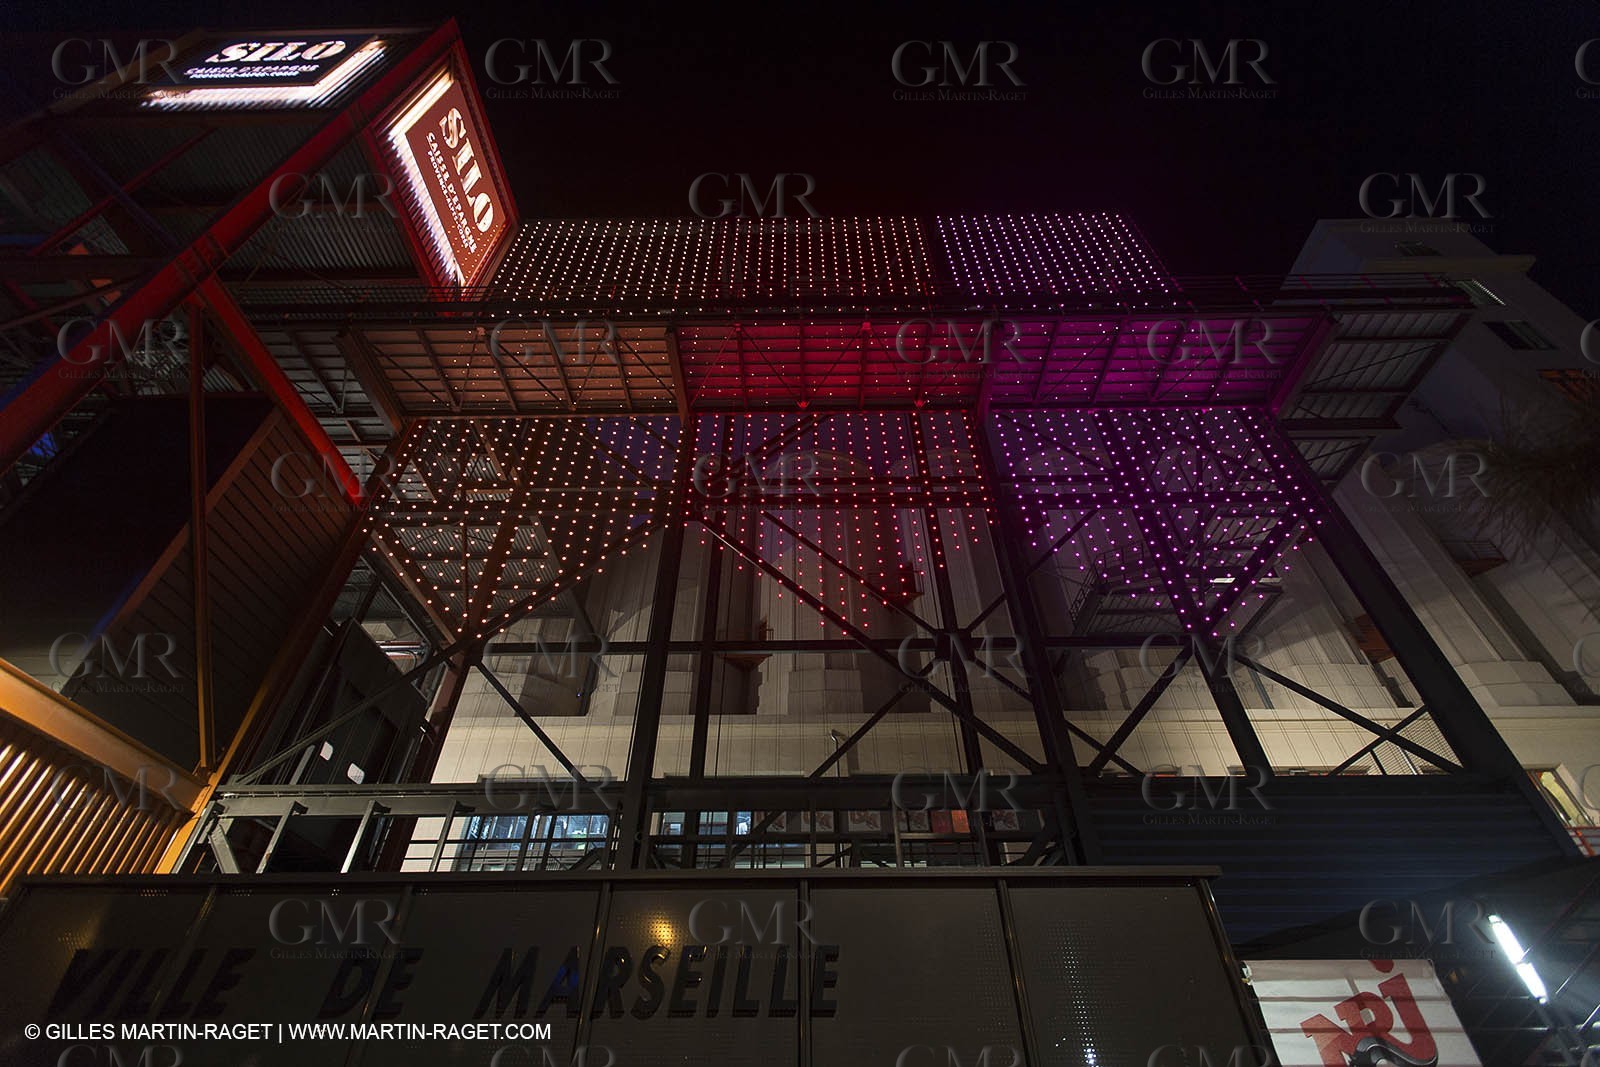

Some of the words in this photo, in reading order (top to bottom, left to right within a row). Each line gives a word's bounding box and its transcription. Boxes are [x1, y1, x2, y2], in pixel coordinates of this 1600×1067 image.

[205, 40, 346, 62] SILO
[426, 132, 450, 182] CAISSE
[439, 107, 494, 233] SILO
[46, 948, 256, 1020] VILLE
[316, 948, 425, 1019] DE
[472, 945, 839, 1019] MARSEILLE
